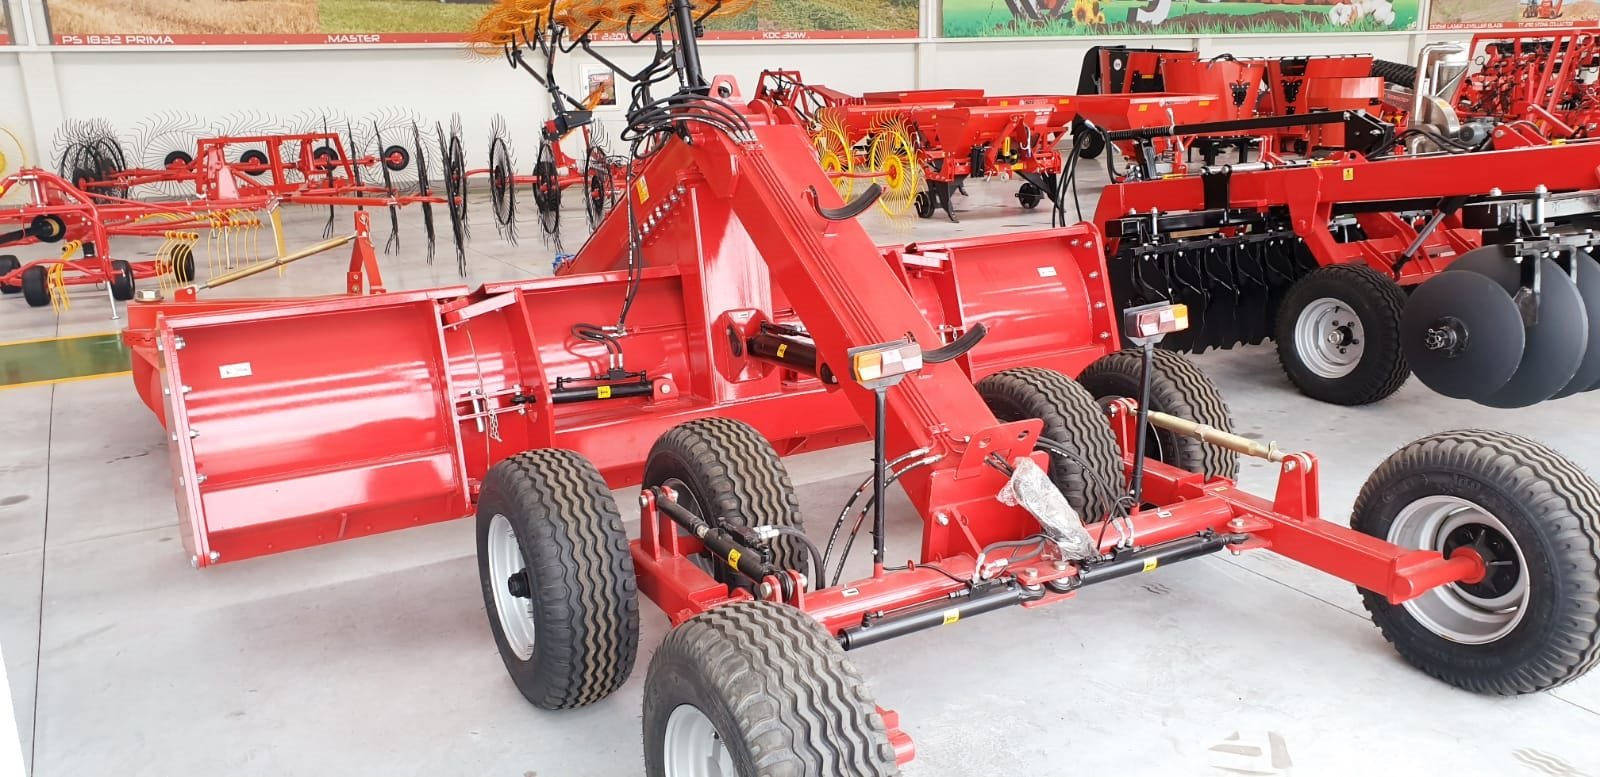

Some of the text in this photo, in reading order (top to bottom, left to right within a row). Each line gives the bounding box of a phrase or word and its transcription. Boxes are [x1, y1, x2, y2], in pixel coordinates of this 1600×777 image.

[61, 35, 175, 44] PS 1832 PRIMA
[327, 34, 381, 43] MASTER
